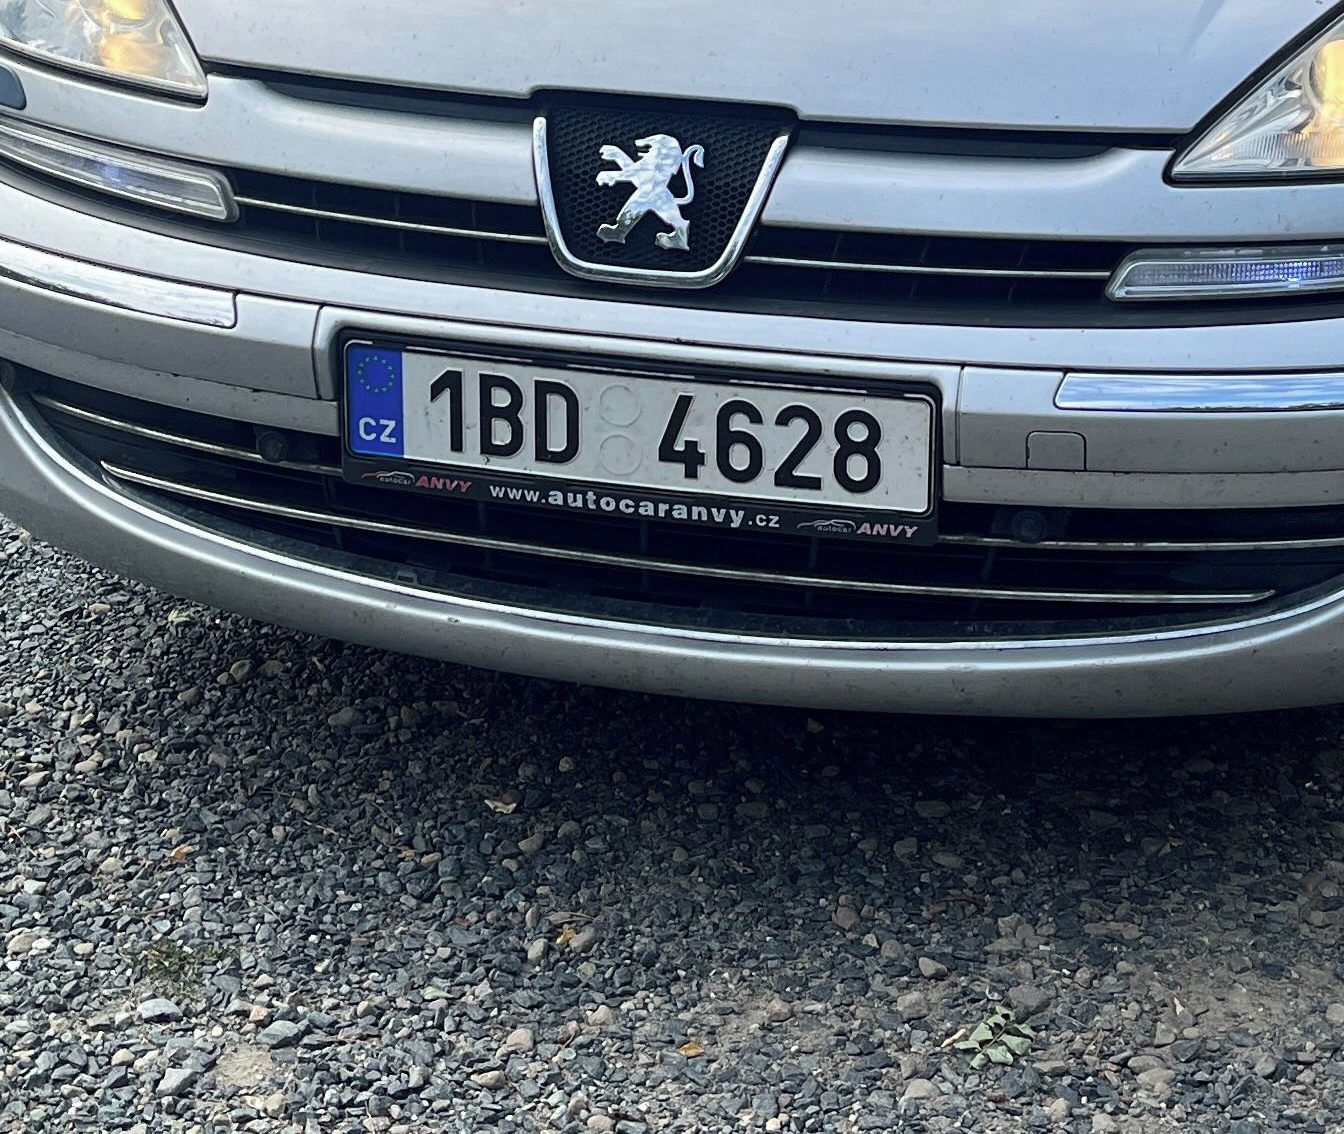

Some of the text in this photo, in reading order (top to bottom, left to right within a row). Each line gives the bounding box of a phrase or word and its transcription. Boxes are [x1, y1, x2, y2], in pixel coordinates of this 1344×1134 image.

[358, 417, 397, 443] CZ
[430, 369, 882, 494] 1BD 4628
[415, 475, 472, 493] ANVY
[489, 484, 780, 528] www.autocaranvy.cz
[856, 522, 918, 538] ANVY
